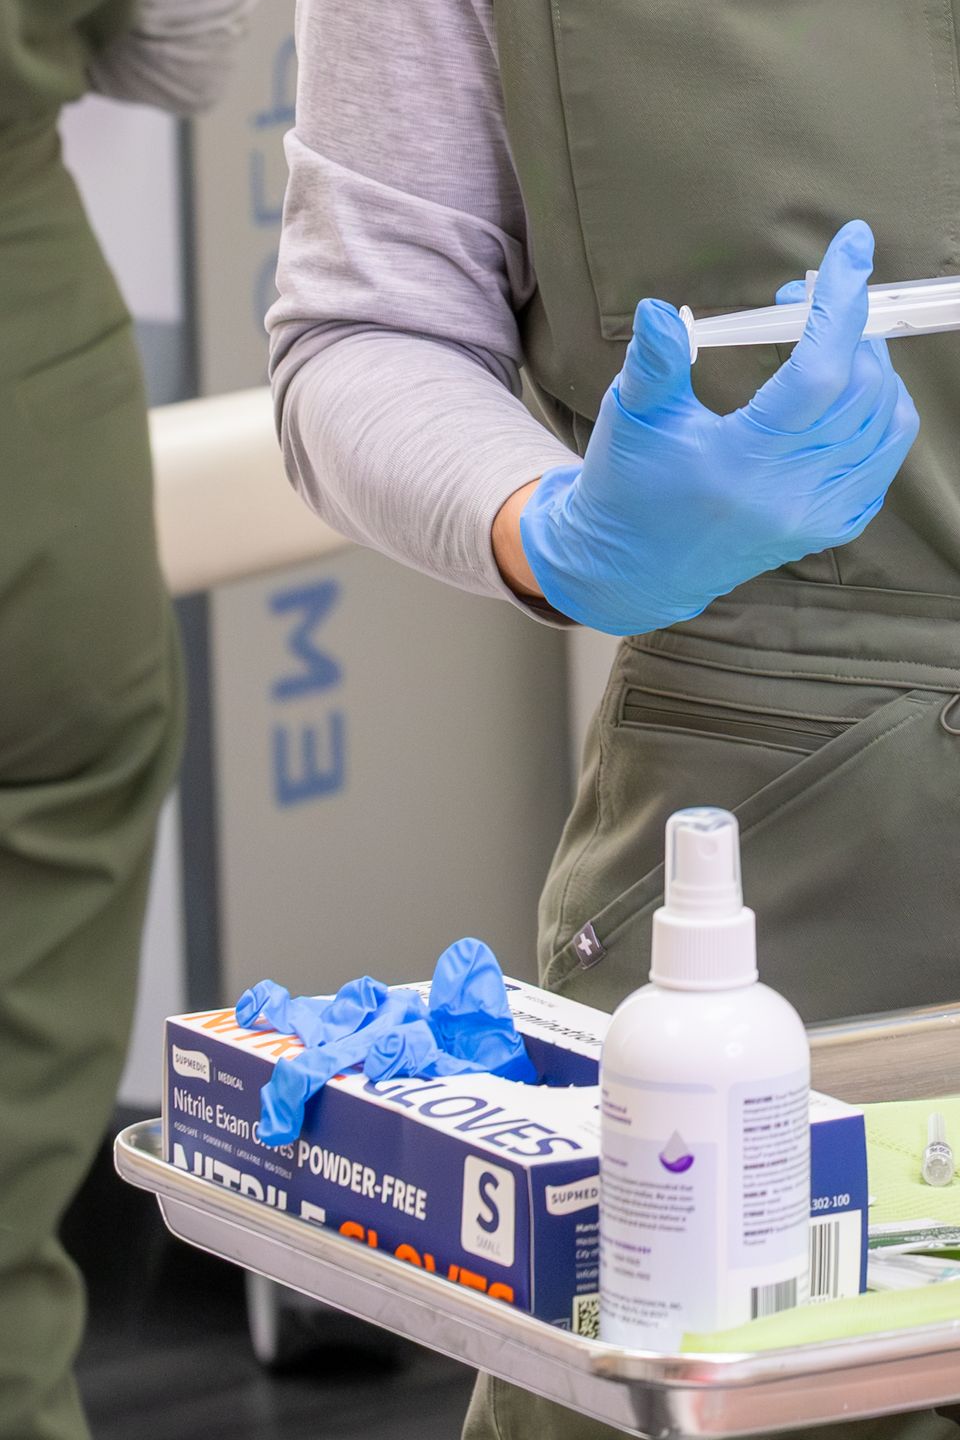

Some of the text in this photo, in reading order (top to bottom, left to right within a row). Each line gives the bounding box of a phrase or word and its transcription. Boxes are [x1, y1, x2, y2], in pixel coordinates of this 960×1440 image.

[175, 1052, 244, 1091] SUPMEDIC MEDICAL
[173, 1086, 214, 1124] Nitrile
[215, 1103, 250, 1140] Exam
[362, 1076, 583, 1157] GLOVES
[297, 1139, 428, 1222] POWDER-FREE
[476, 1170, 500, 1234] S
